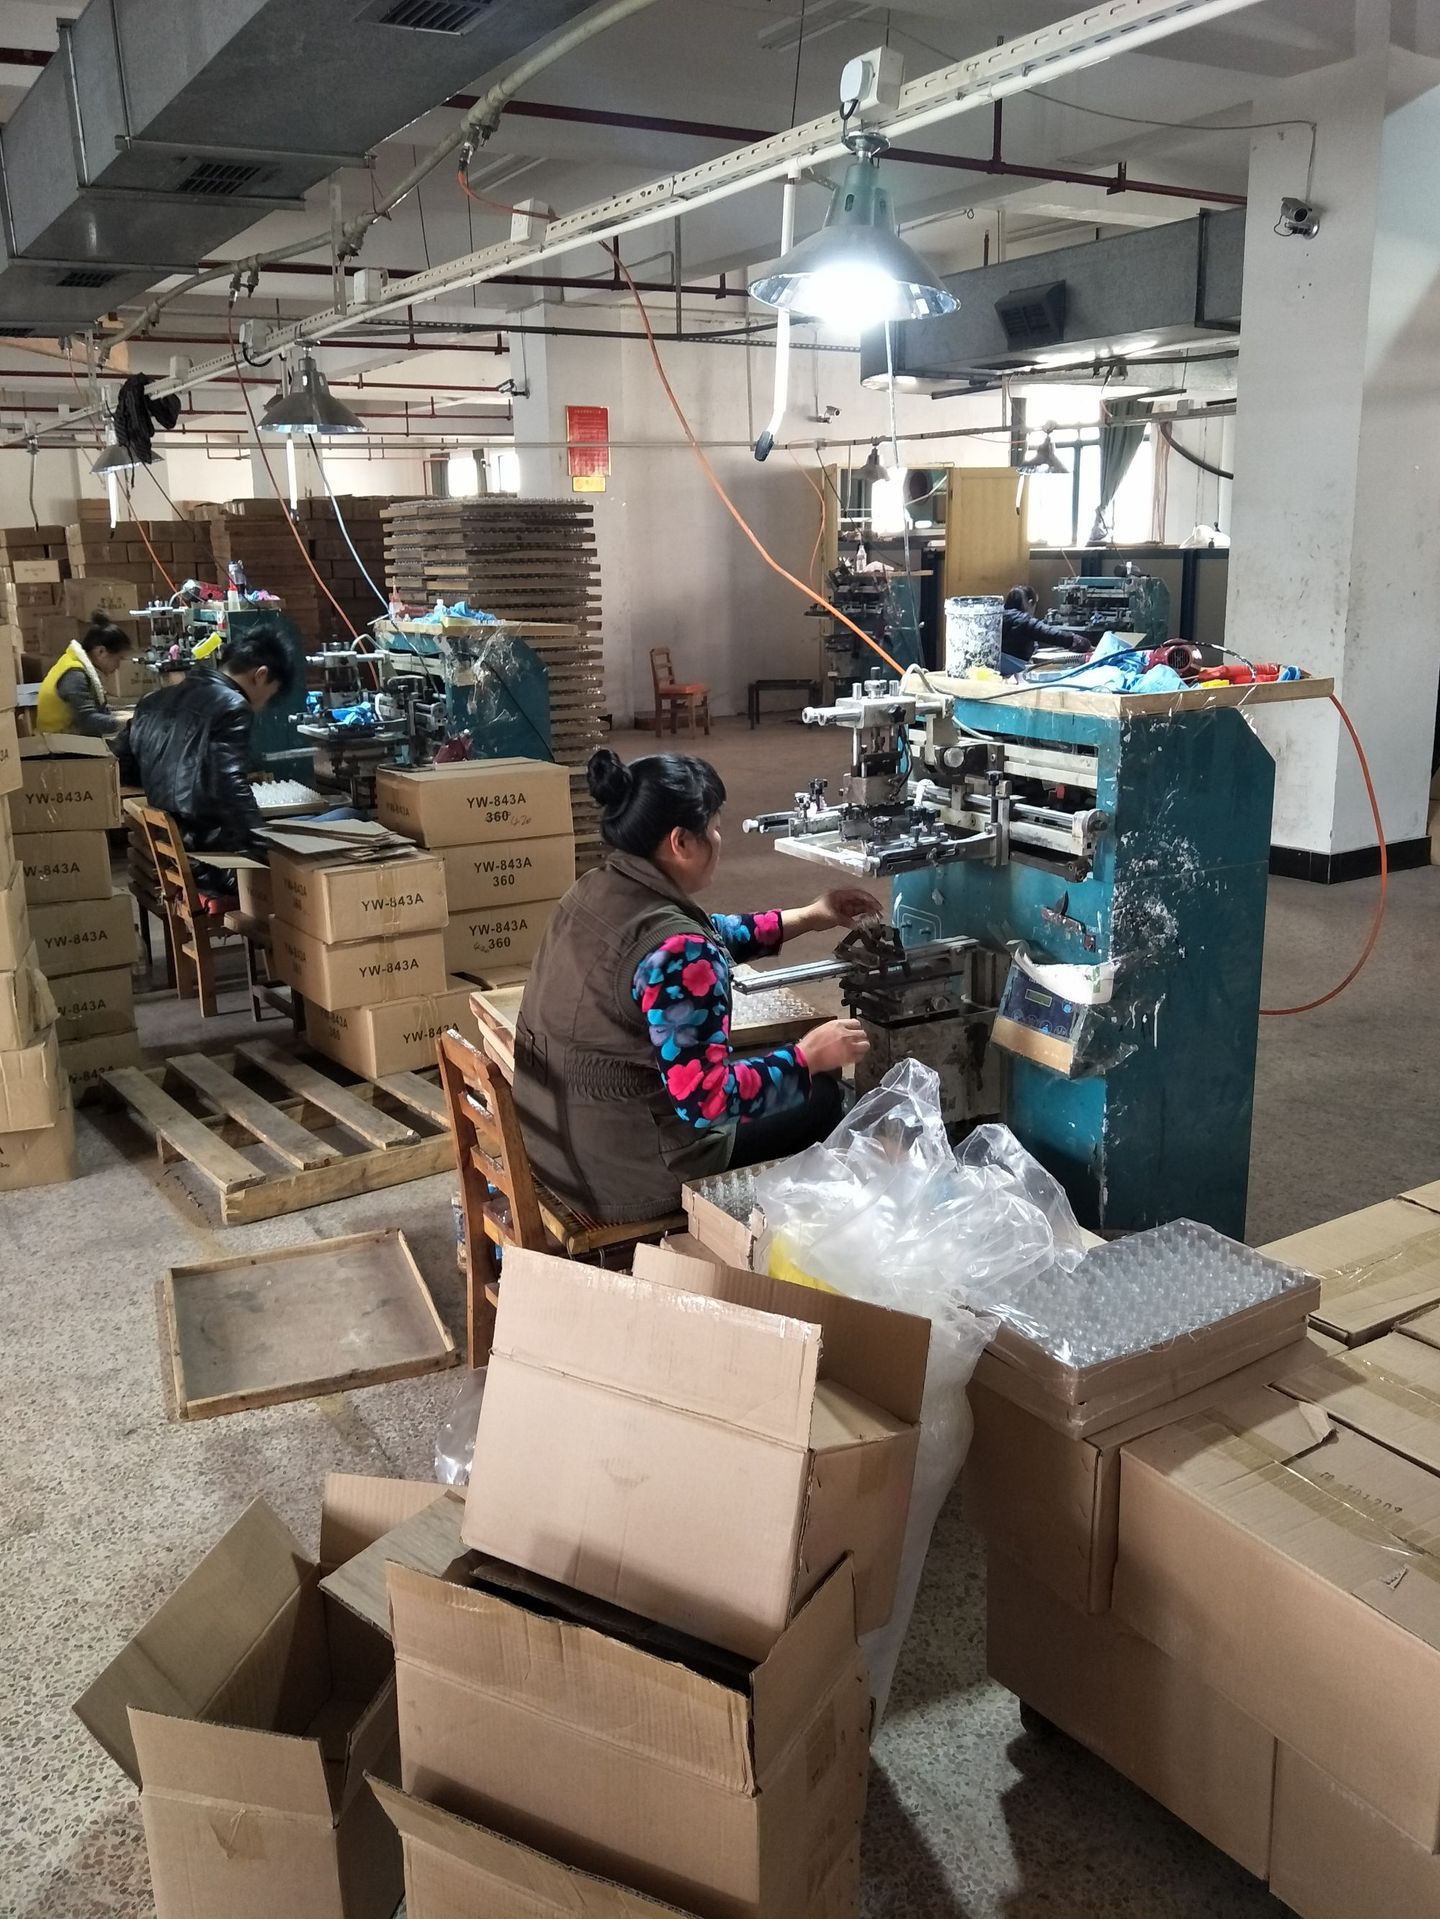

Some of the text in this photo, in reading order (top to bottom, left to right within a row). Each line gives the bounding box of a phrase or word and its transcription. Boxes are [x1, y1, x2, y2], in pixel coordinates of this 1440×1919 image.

[25, 790, 93, 804] YW-843A
[466, 793, 527, 809] YW-843A
[486, 810, 509, 823] 360
[24, 862, 80, 878] W-843A
[474, 857, 532, 873] YW-843A
[492, 874, 515, 887] 360
[361, 893, 424, 911] YW-843A
[469, 919, 528, 936] YW-843A
[44, 930, 108, 949] YW-843A
[488, 936, 511, 949] 360
[359, 958, 419, 978] YW-843A
[58, 999, 106, 1017] W-843A
